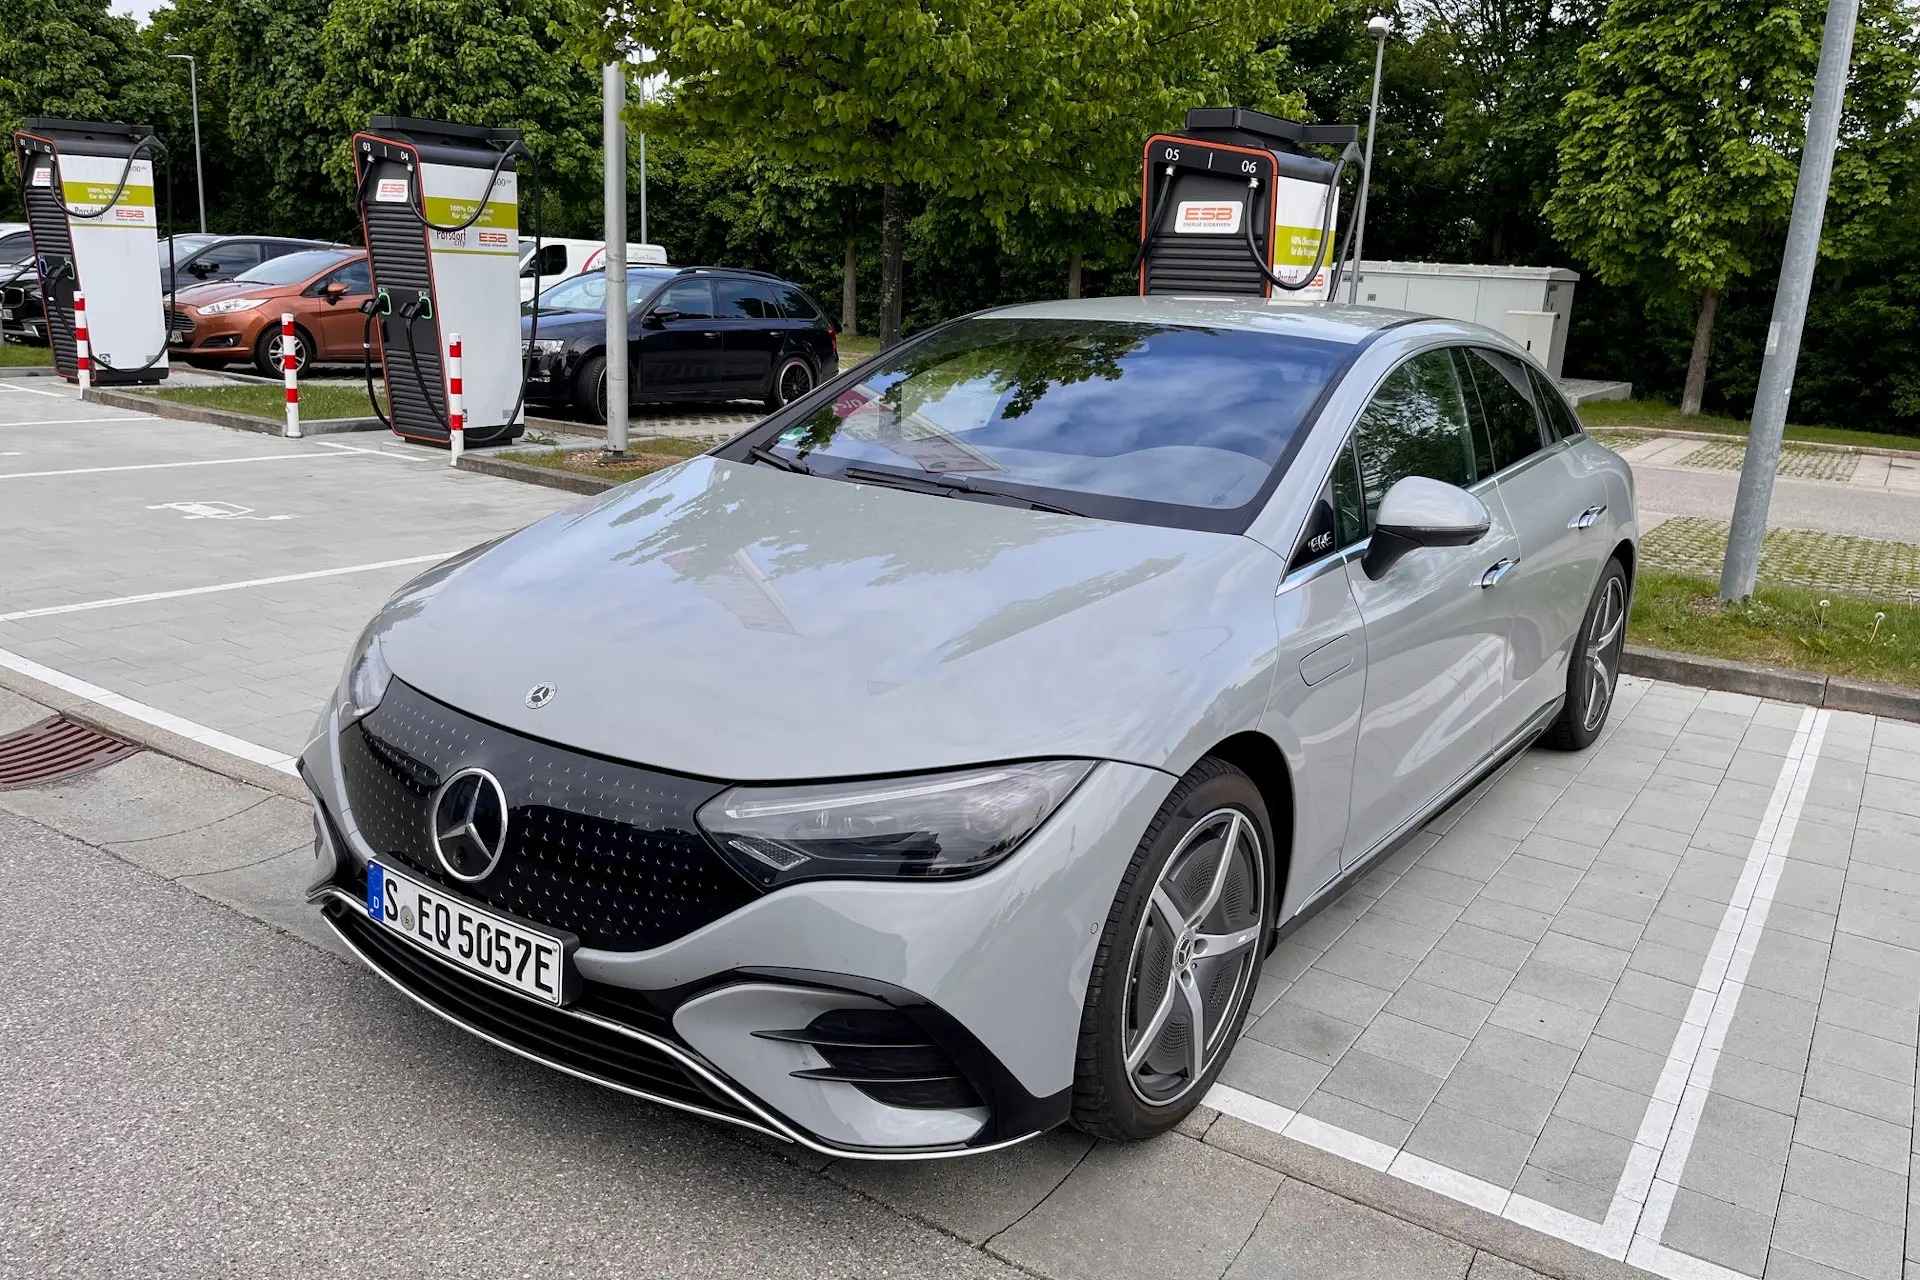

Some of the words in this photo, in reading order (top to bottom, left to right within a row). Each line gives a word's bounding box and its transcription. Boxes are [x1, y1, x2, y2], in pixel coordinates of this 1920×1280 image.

[362, 142, 371, 152] 03
[400, 150, 409, 161] 04
[1165, 148, 1180, 160] 05
[1242, 160, 1257, 173] 06
[116, 210, 144, 218] ESB
[1184, 207, 1232, 220] ESB
[479, 232, 508, 242] ESB
[373, 896, 380, 908] D
[384, 878, 398, 922] S
[418, 893, 451, 950] EQ
[458, 912, 553, 994] 5057E
